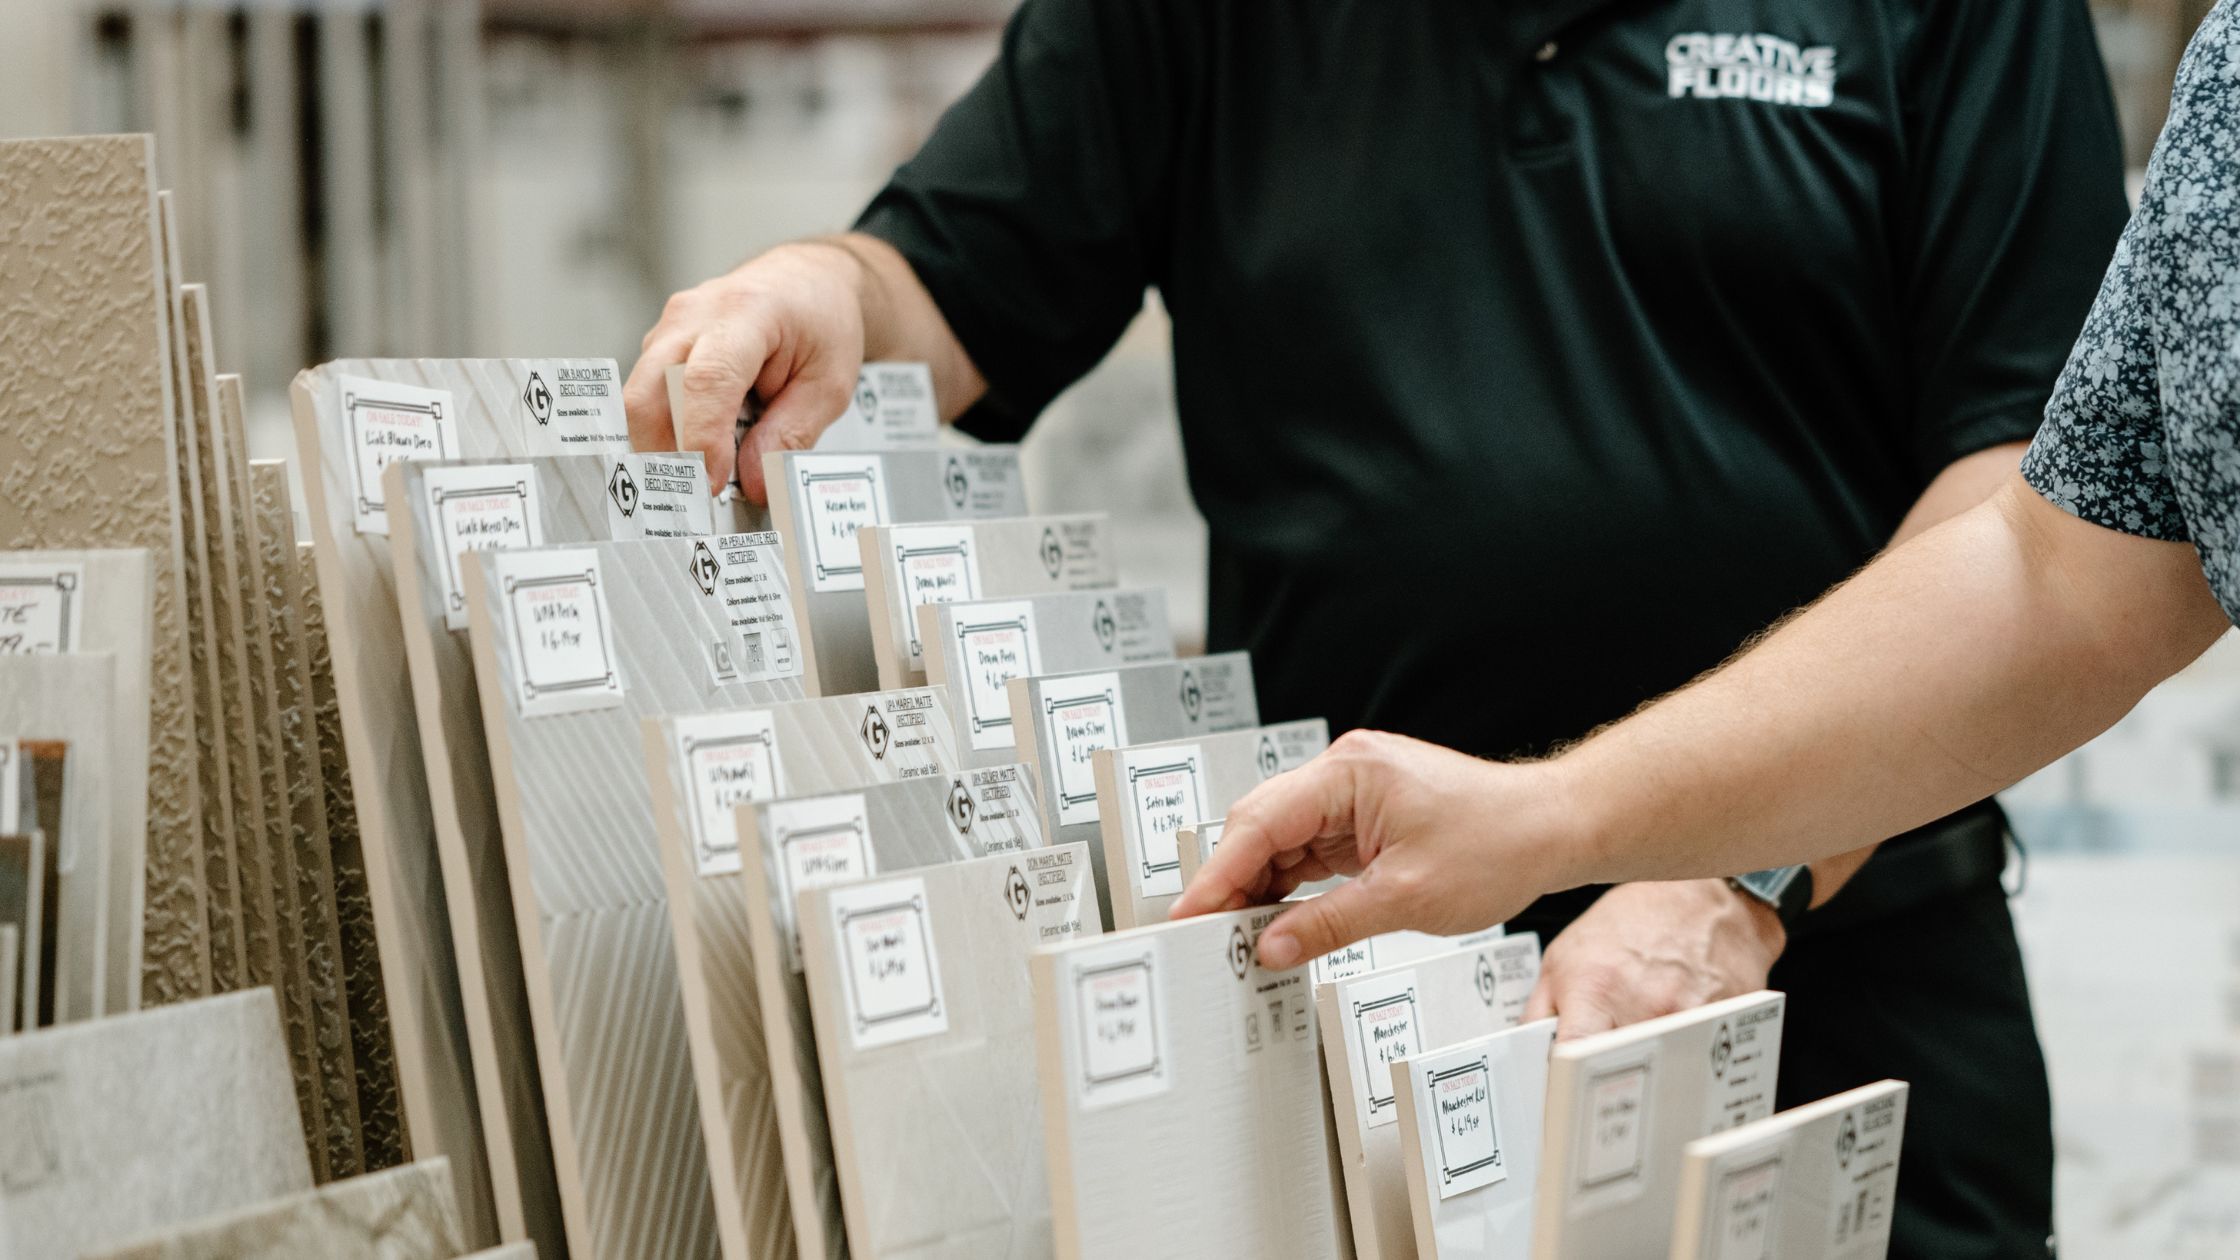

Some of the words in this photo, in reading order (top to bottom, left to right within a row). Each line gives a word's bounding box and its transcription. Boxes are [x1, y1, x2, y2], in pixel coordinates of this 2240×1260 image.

[1665, 31, 1836, 75] CREATIVE
[1668, 66, 1834, 107] FLOORS
[557, 368, 570, 379] LINK
[591, 368, 611, 380] MATTE
[560, 384, 576, 395] DECO
[645, 462, 658, 473] LINK
[675, 465, 696, 477] MATTE
[645, 478, 661, 489] DECO
[728, 535, 745, 547] PERLA
[745, 533, 763, 545] MATTE
[726, 550, 758, 565] (RECTIFIED)
[914, 695, 933, 707] MATTE
[999, 767, 1016, 780] MATTE
[1056, 851, 1073, 864] MATTE
[1373, 1020, 1407, 1044] Manchester
[1442, 1093, 1474, 1115] Manchester
